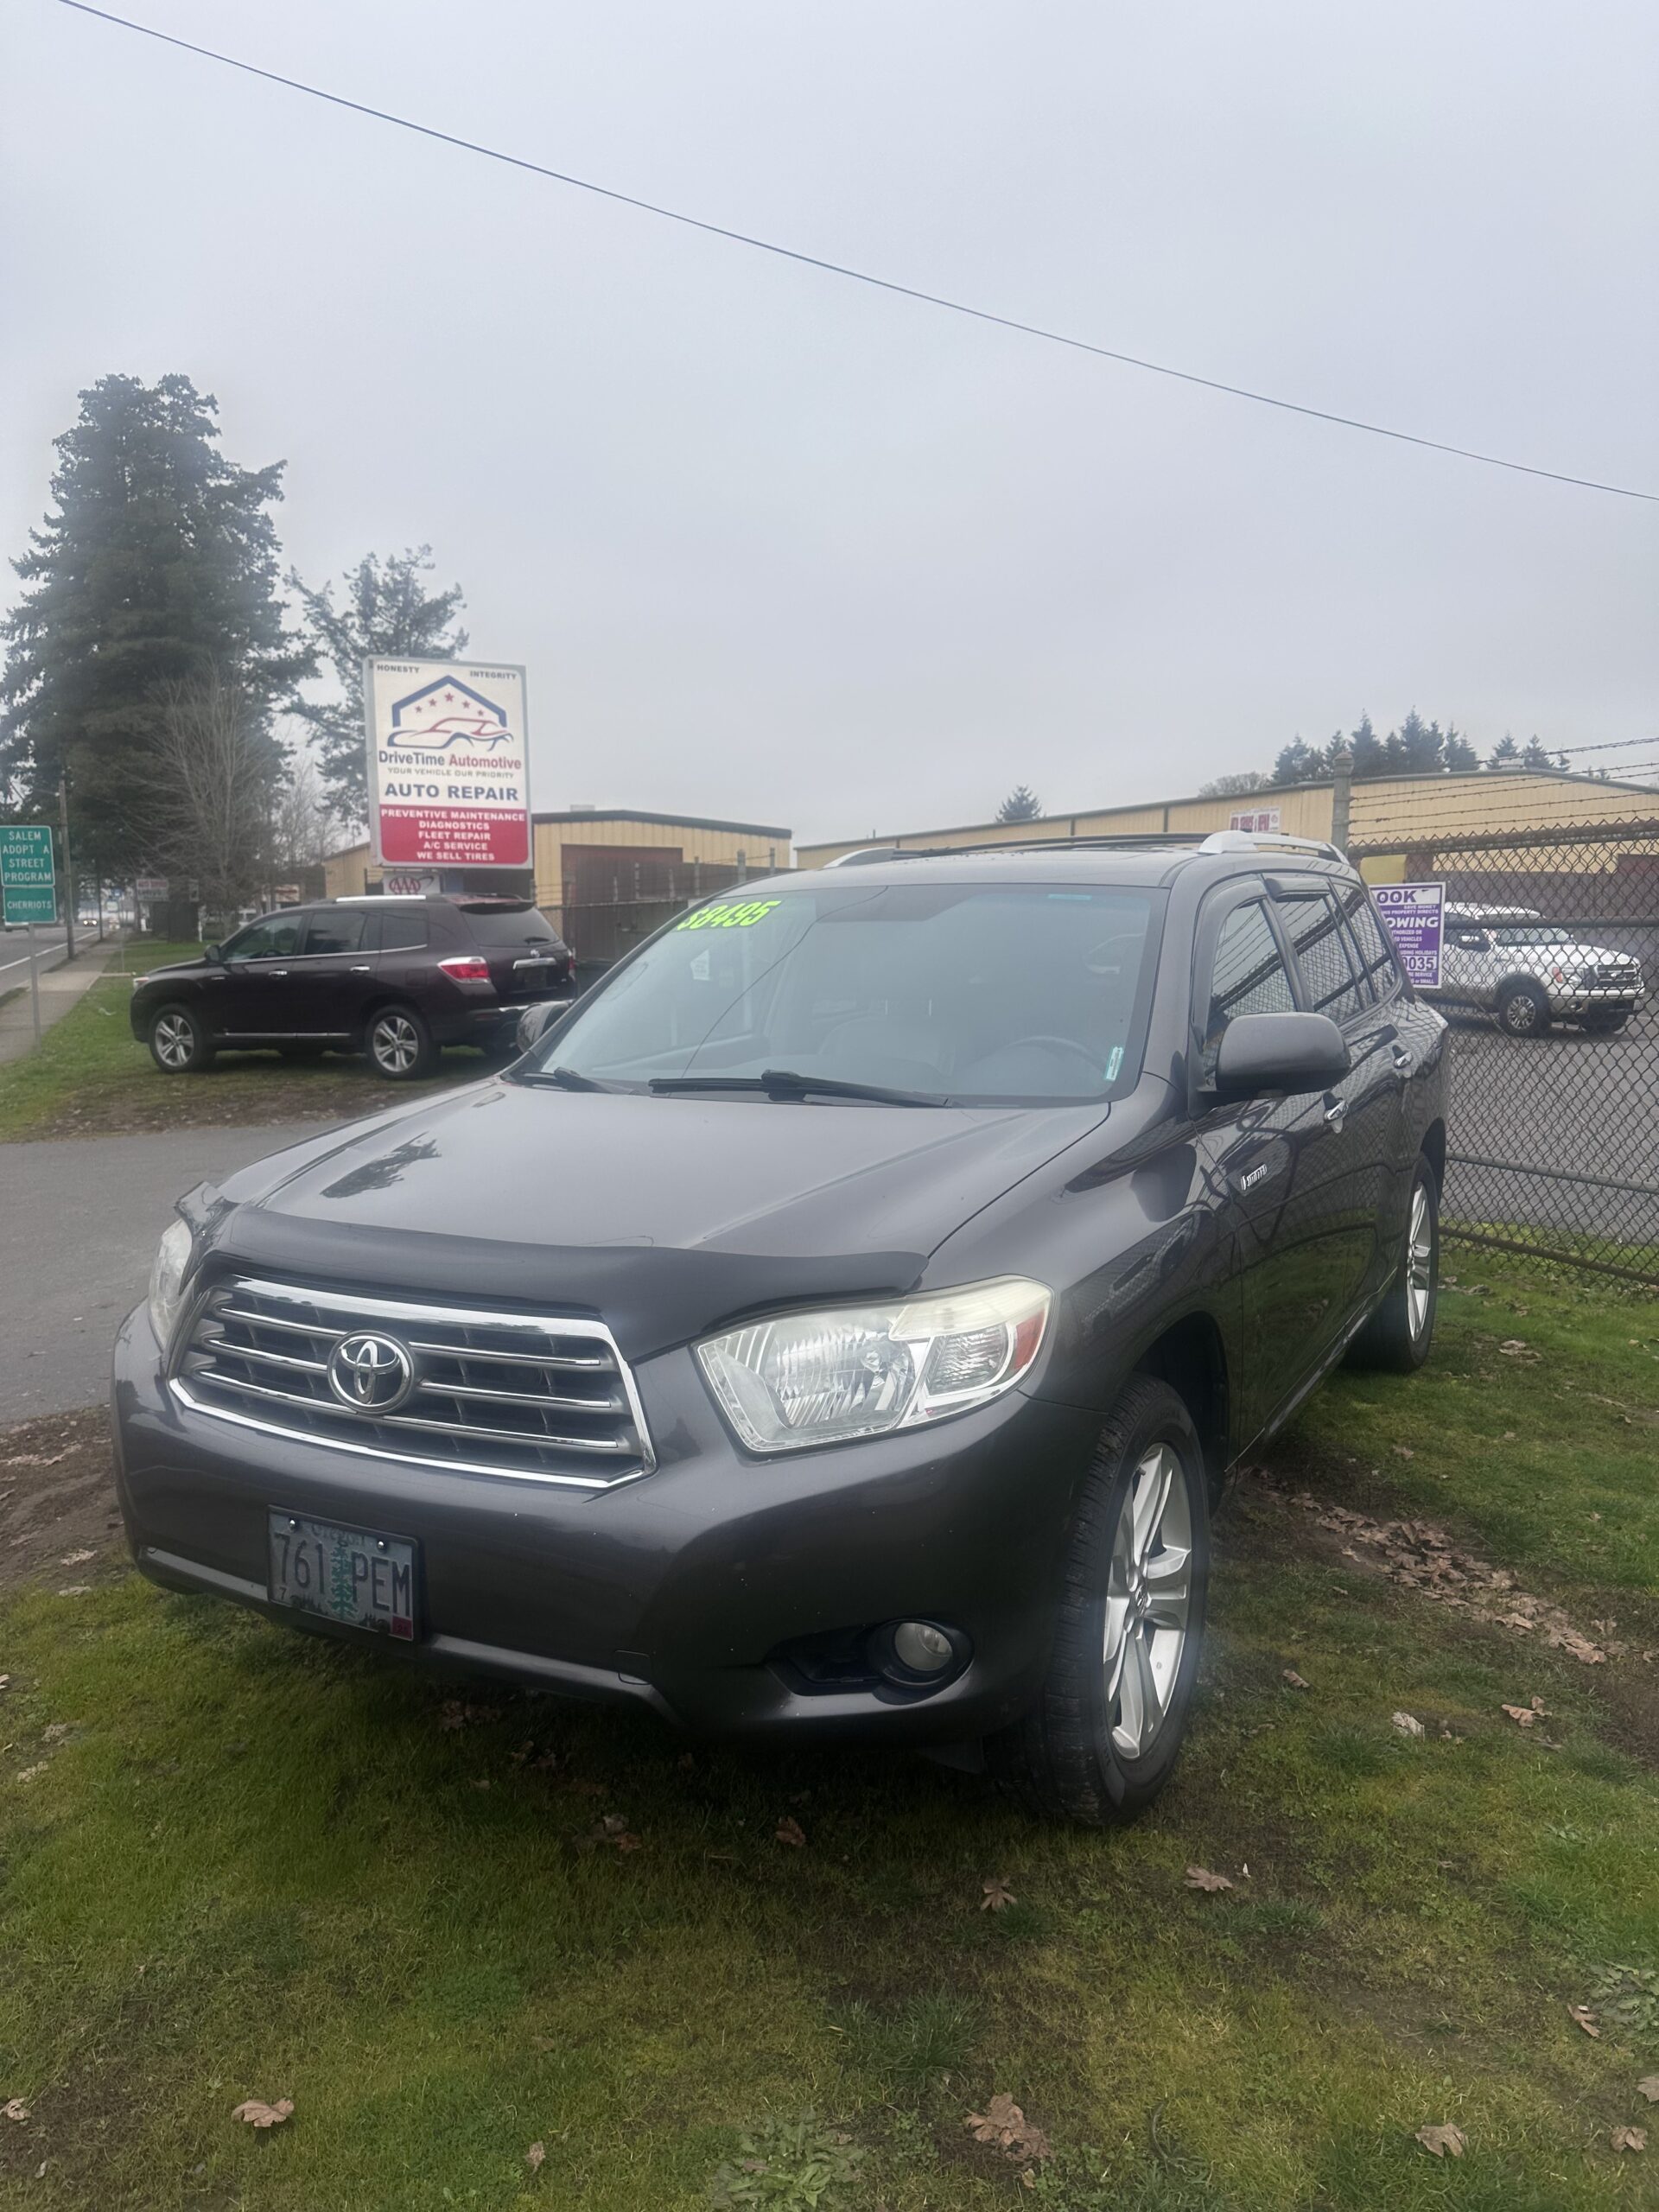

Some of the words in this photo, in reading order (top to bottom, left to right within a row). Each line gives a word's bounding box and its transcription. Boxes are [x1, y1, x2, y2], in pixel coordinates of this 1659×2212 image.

[377, 664, 420, 673] HONESTY
[470, 671, 518, 680] INTEGRITY
[378, 750, 445, 766] DriveTime
[449, 753, 522, 769] Automotive
[385, 783, 440, 798] AUTO
[448, 785, 518, 801] REPAIR
[381, 809, 448, 819] PREVENTIVE
[450, 810, 525, 821] MAINTENANCE
[418, 821, 490, 830] DIAGNOSTICS
[9, 831, 41, 841] SALEM
[454, 832, 491, 841] REPAIR
[3, 844, 34, 854] ADOPT
[43, 844, 49, 854] A
[443, 842, 488, 850] SERVICE
[436, 852, 461, 861] SELL
[9, 858, 44, 868] STREET
[4, 872, 51, 881] PROGRAM
[391, 874, 419, 895] AAA
[7, 900, 52, 909] CHERRIOTS
[274, 1531, 326, 1596] 761
[351, 1550, 410, 1618] PEM
